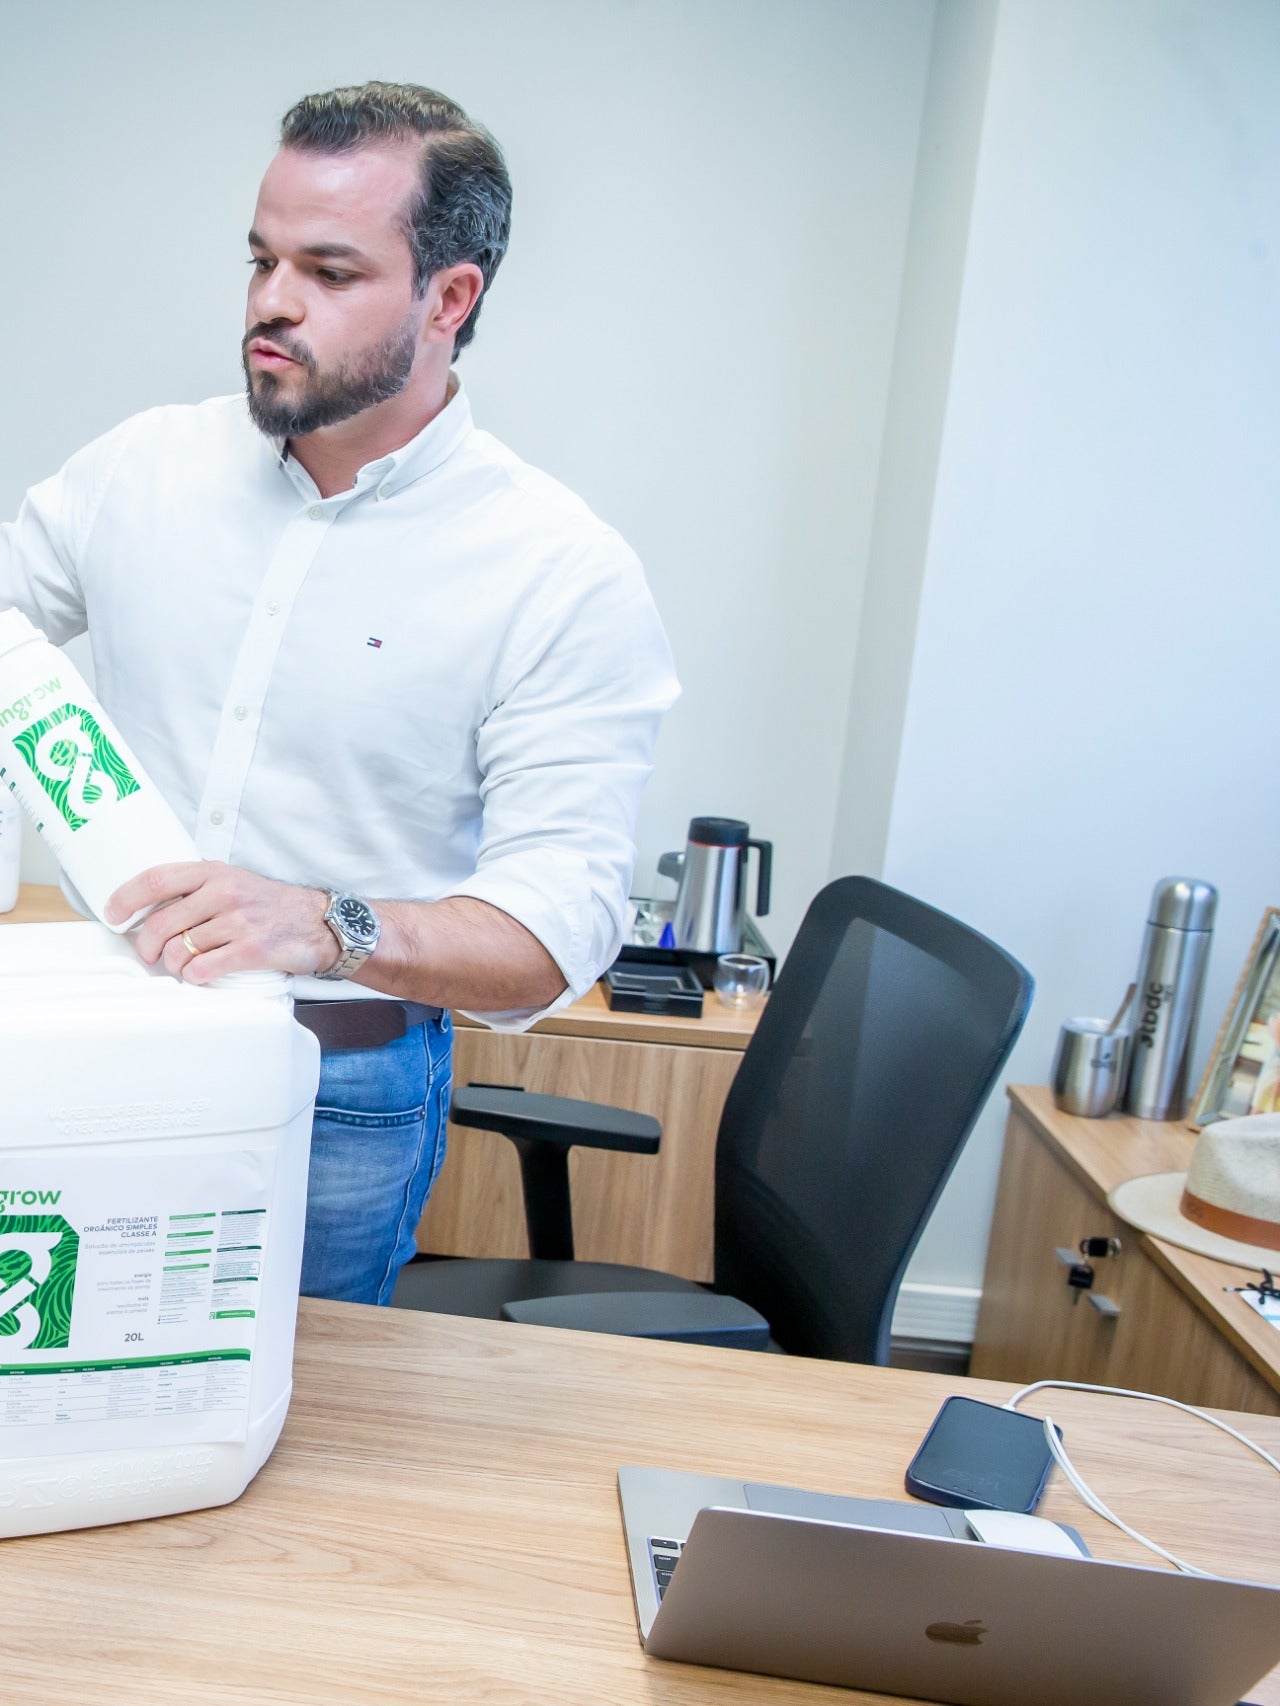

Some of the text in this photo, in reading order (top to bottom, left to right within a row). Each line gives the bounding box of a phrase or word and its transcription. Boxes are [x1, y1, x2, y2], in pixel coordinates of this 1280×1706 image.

[107, 1215, 159, 1225] FERTILIZANTE
[125, 1223, 158, 1231] SIMPLES
[124, 1332, 144, 1342] 20L
